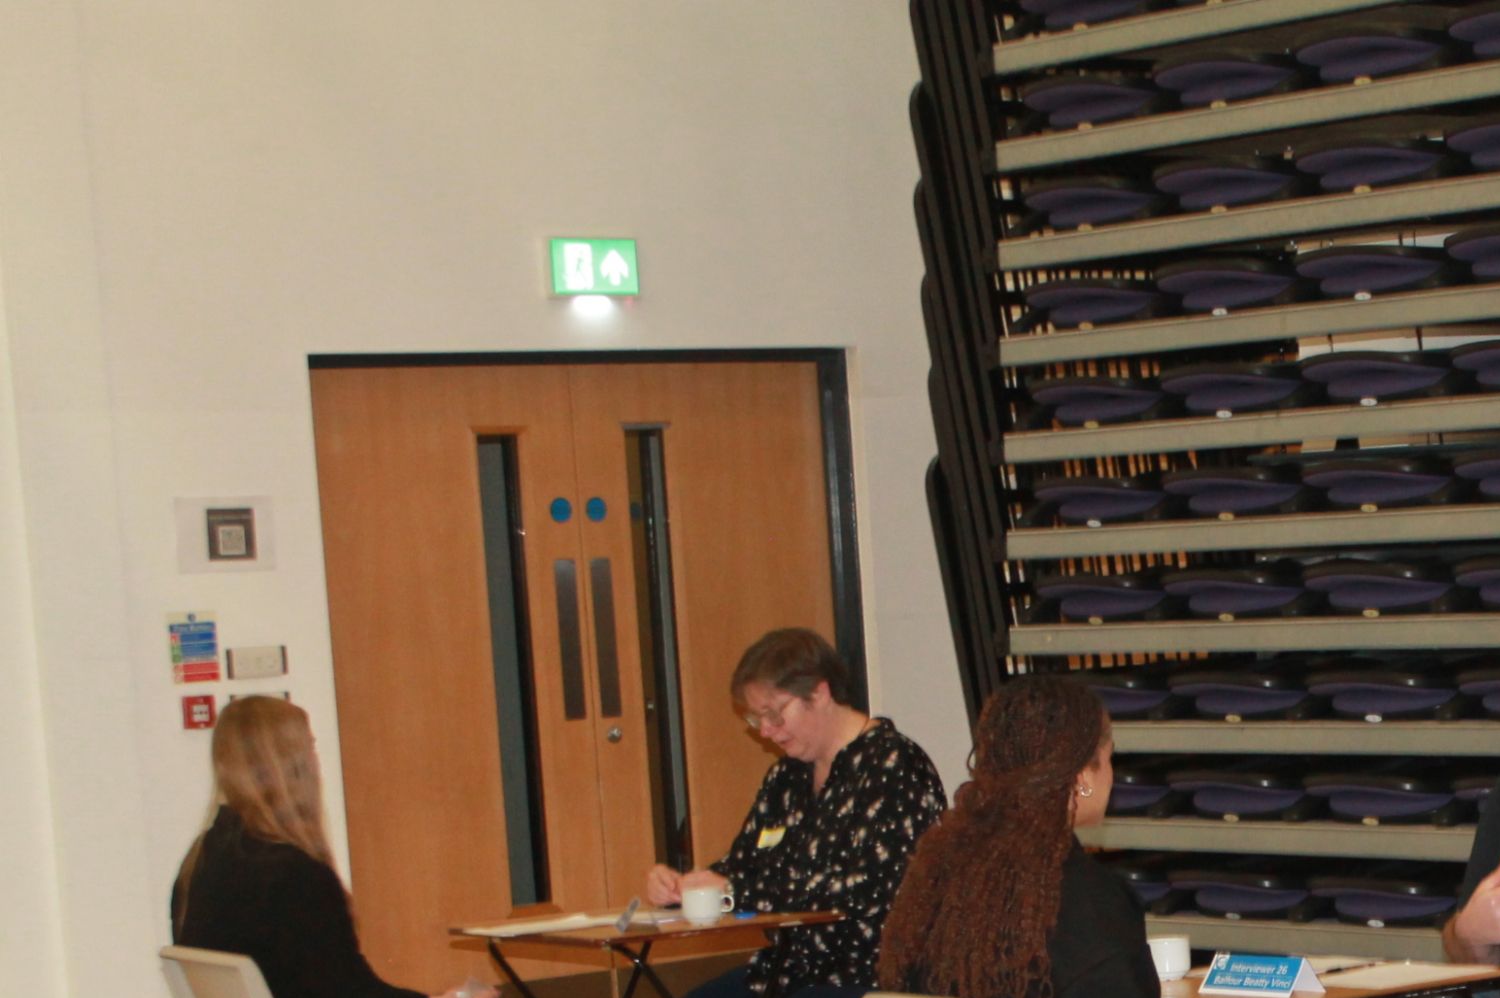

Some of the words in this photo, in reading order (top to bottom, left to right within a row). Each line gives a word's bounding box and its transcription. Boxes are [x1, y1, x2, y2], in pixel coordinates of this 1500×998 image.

[1230, 963, 1275, 974] Interviewer
[1276, 965, 1288, 975] 26
[1213, 975, 1242, 985] Balfour
[1243, 976, 1270, 989] Beatty
[1271, 977, 1292, 988] Vinci
